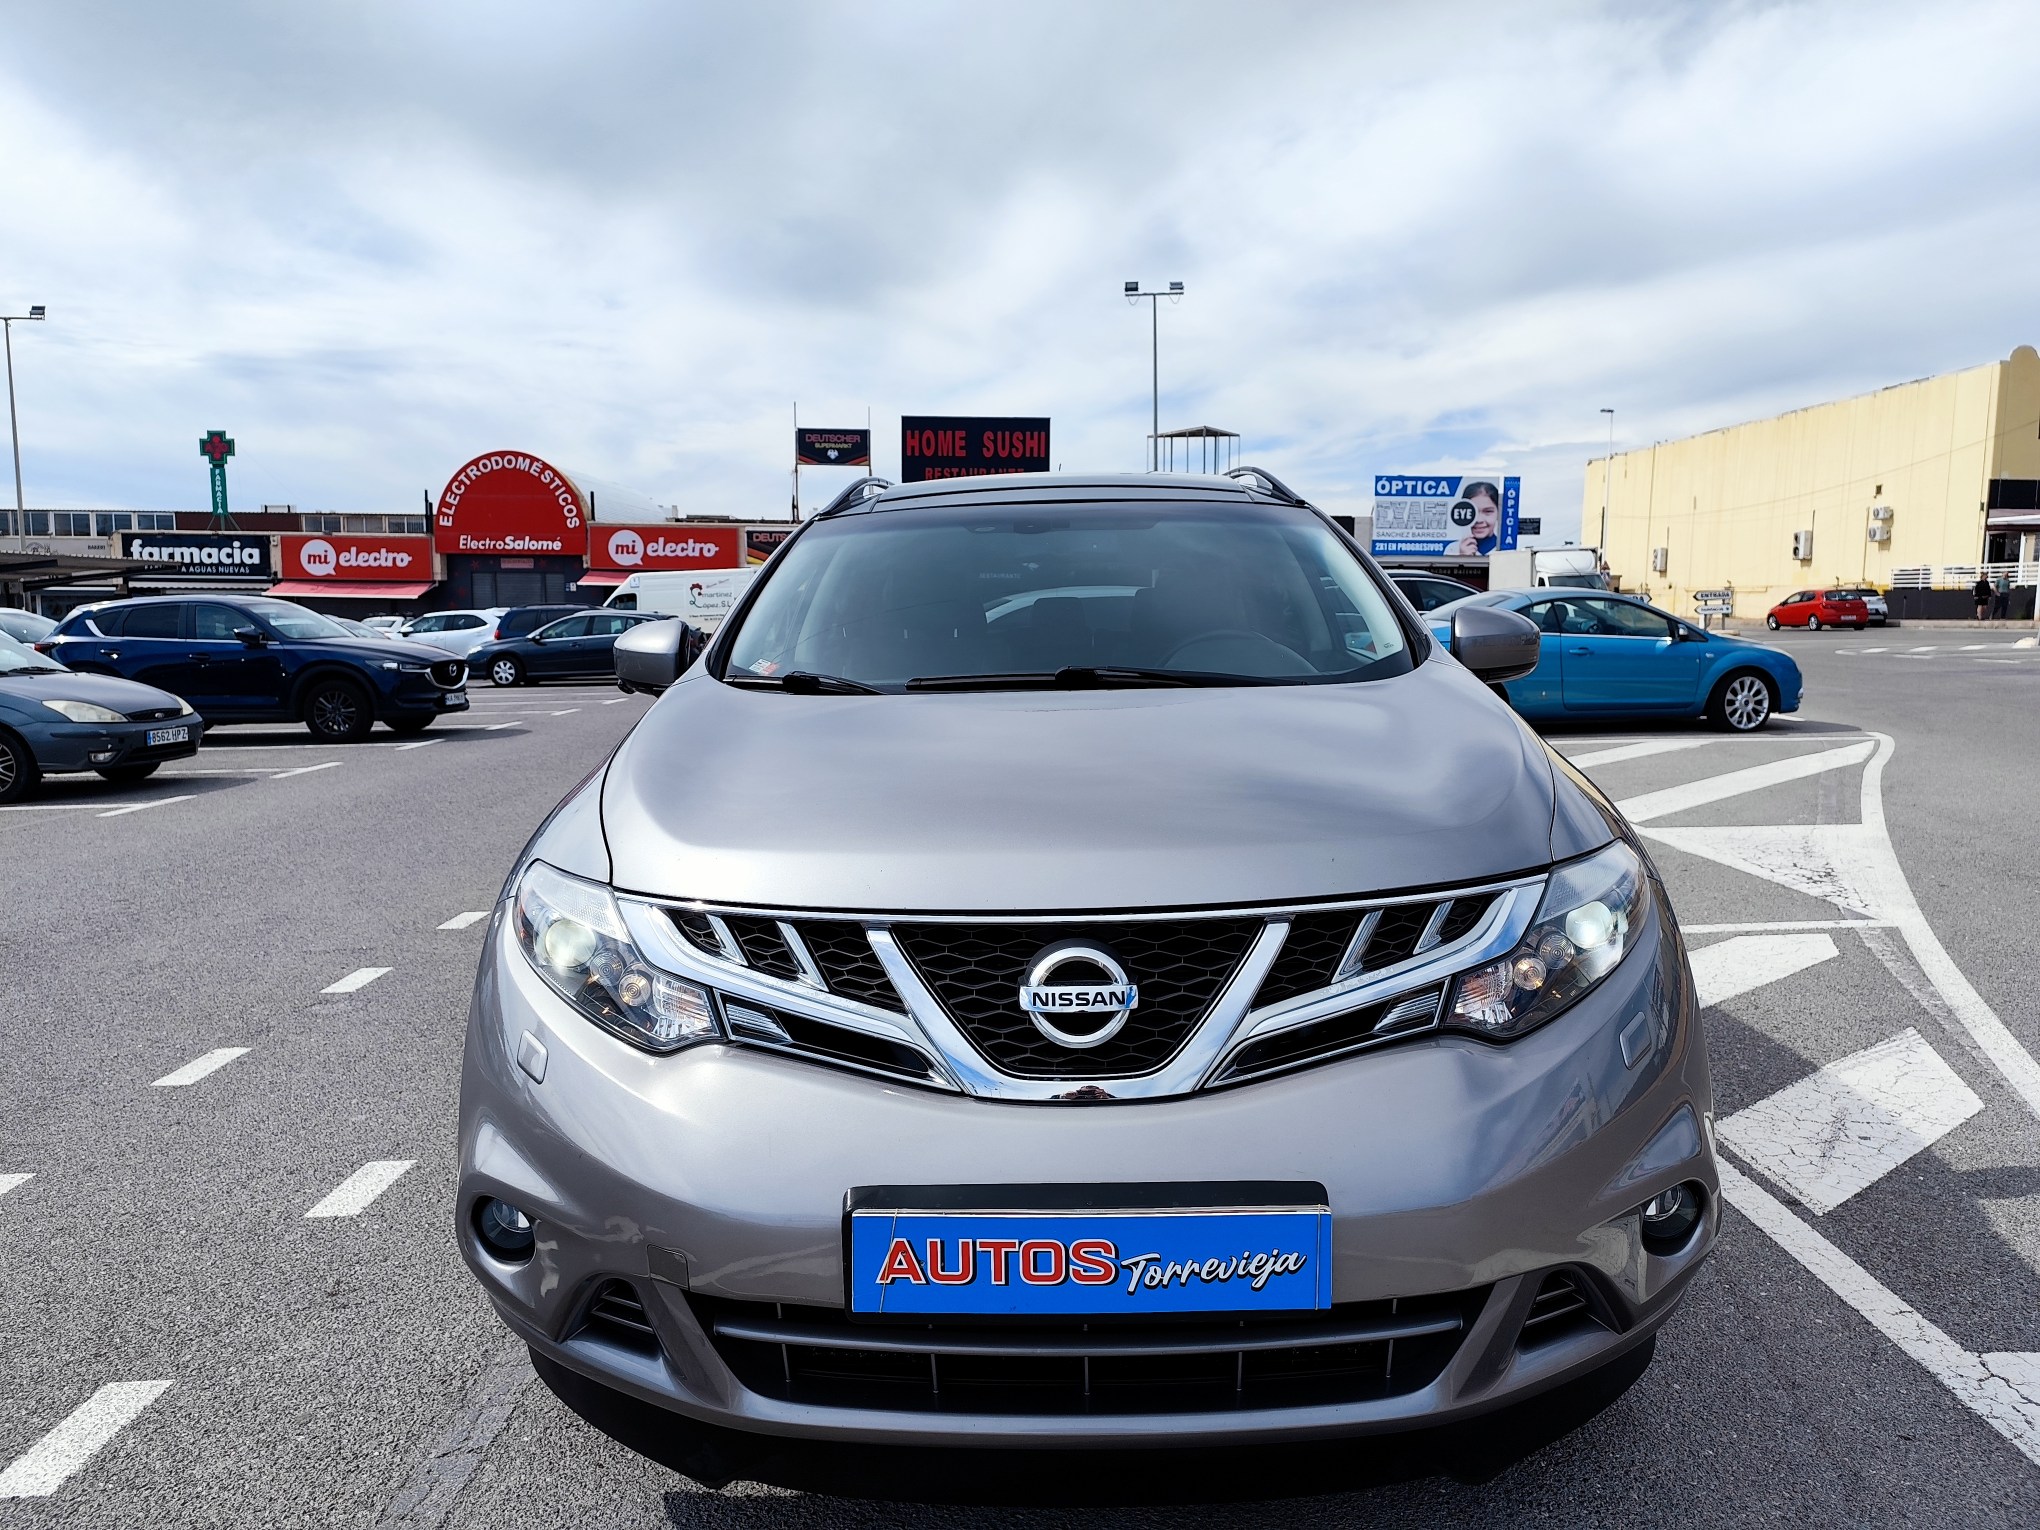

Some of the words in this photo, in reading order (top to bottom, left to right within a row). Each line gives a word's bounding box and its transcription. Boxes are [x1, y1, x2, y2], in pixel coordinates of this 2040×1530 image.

[805, 434, 861, 443] DEUTSCHER
[906, 430, 966, 457] HOME
[982, 430, 1046, 458] SUSHI
[215, 468, 224, 514] FARMACIA
[439, 454, 580, 529] ELECTRODOMÉSTICOS
[1376, 477, 1451, 495] ÓPTICA
[1453, 508, 1473, 520] EYE
[130, 538, 261, 565] farmacia
[307, 549, 331, 565] mi
[338, 546, 413, 568] electro
[614, 540, 638, 555] mi
[646, 537, 720, 558] electro
[1032, 990, 1126, 1007] NISSAN
[876, 1237, 1119, 1286] AUTOS
[1121, 1247, 1308, 1296] Torrevieja
